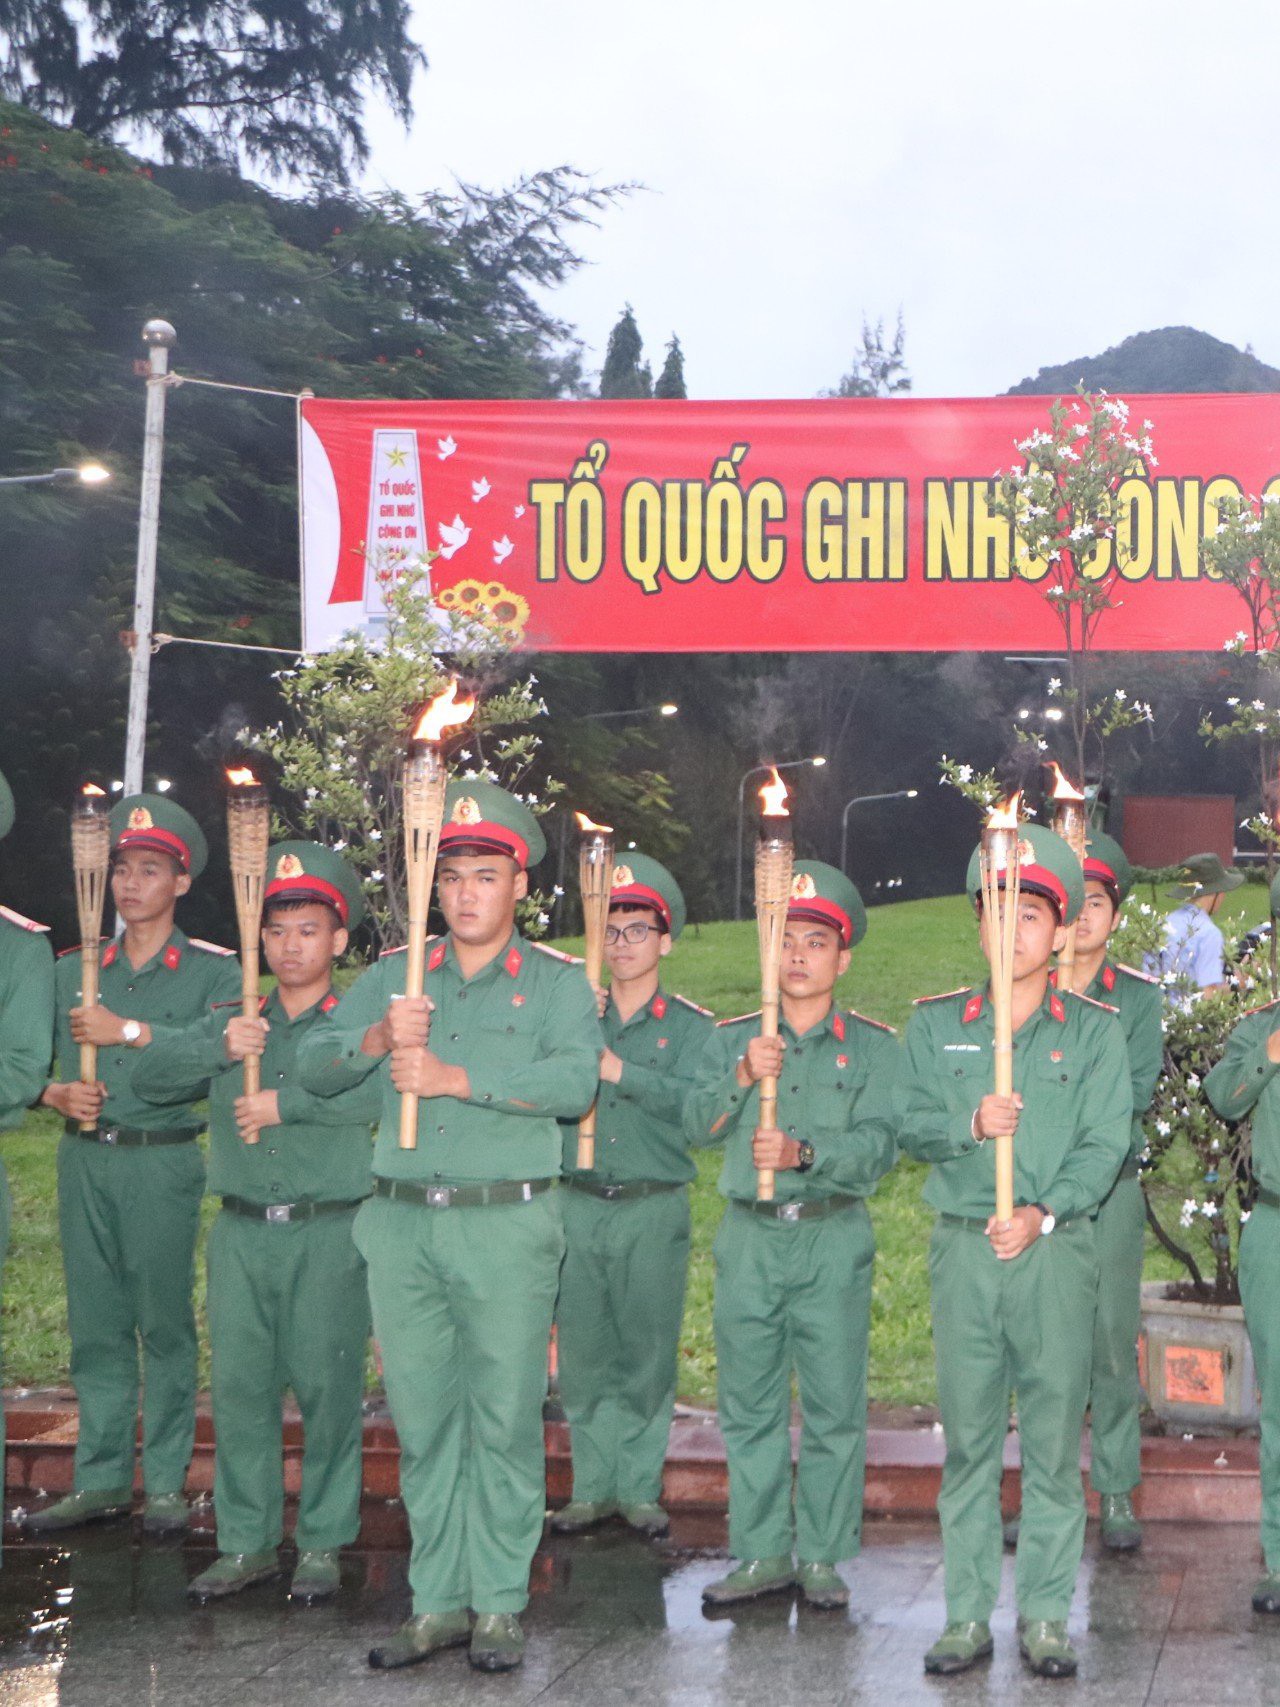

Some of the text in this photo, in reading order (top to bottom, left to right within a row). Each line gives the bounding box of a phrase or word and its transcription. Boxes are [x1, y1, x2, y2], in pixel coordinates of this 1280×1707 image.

[529, 438, 609, 582] TỔ
[621, 441, 787, 595] QUỐC
[804, 476, 908, 582] GHI
